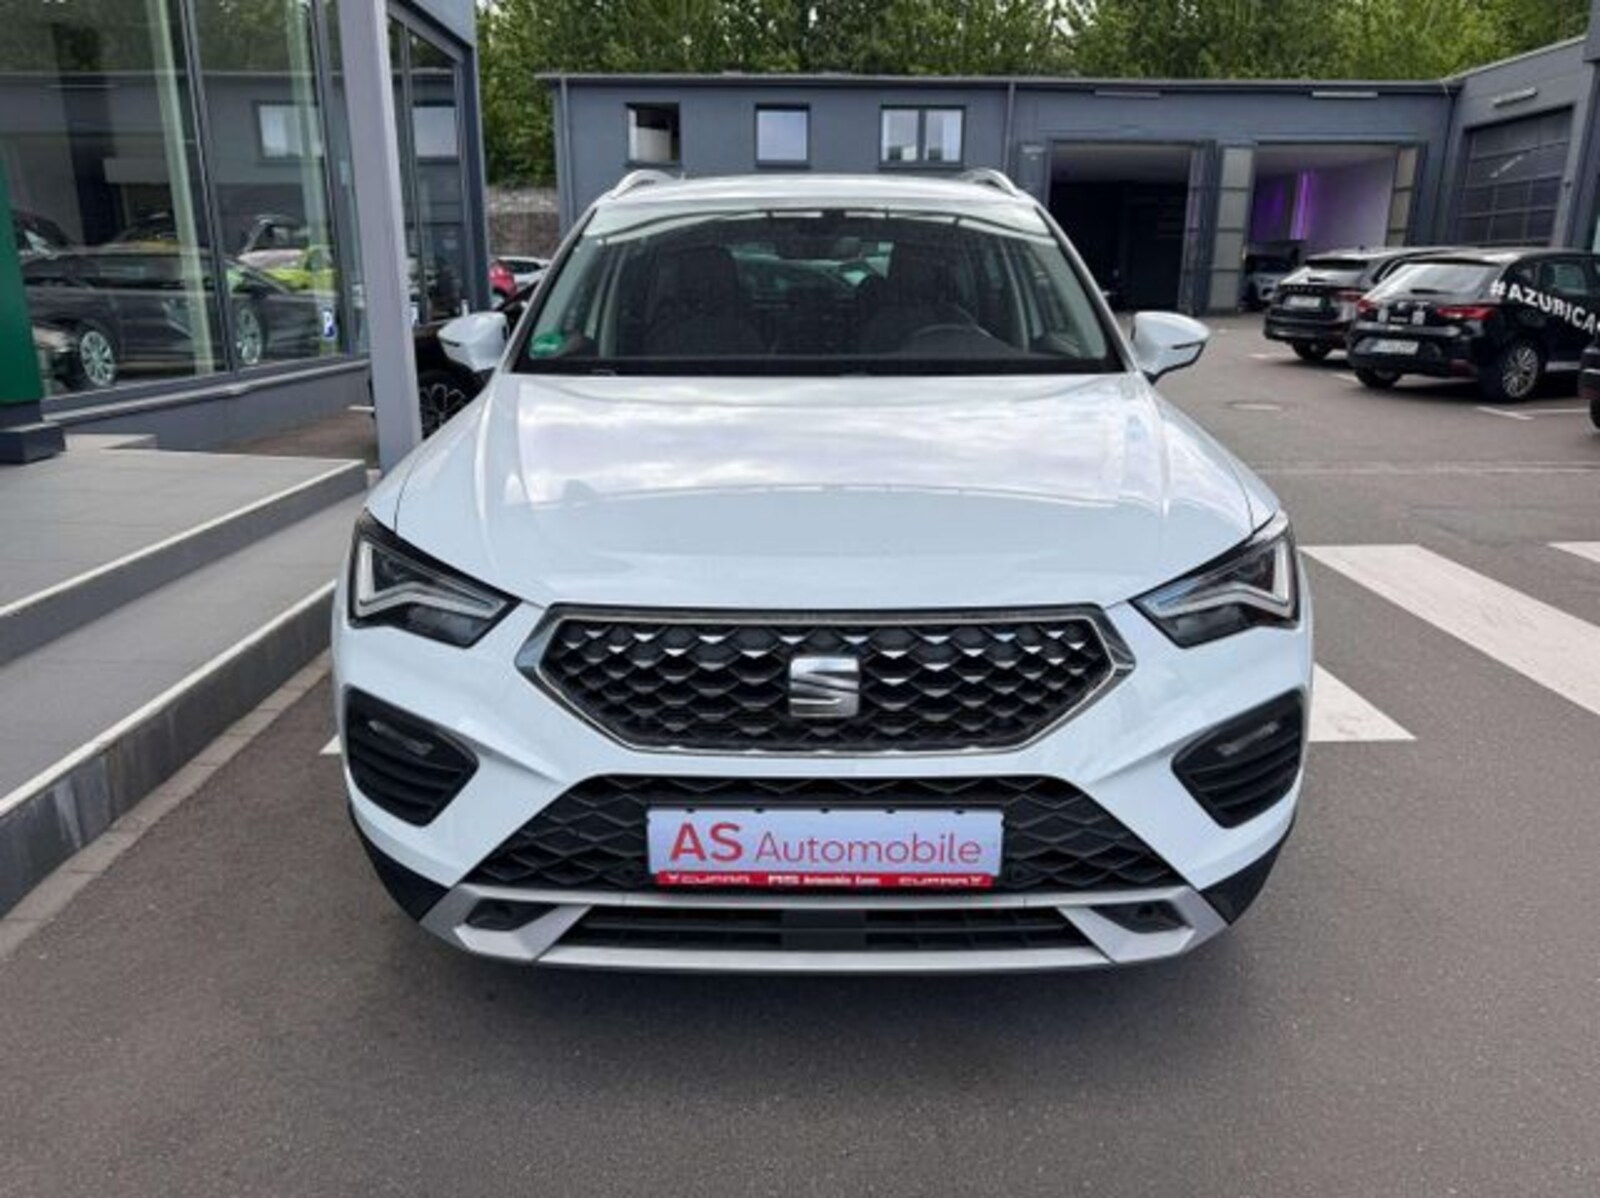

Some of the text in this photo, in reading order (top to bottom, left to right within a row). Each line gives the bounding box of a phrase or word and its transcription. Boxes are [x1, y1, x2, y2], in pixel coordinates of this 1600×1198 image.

[1490, 280, 1600, 334] #AZUBICA
[669, 821, 982, 864] AS Automobile
